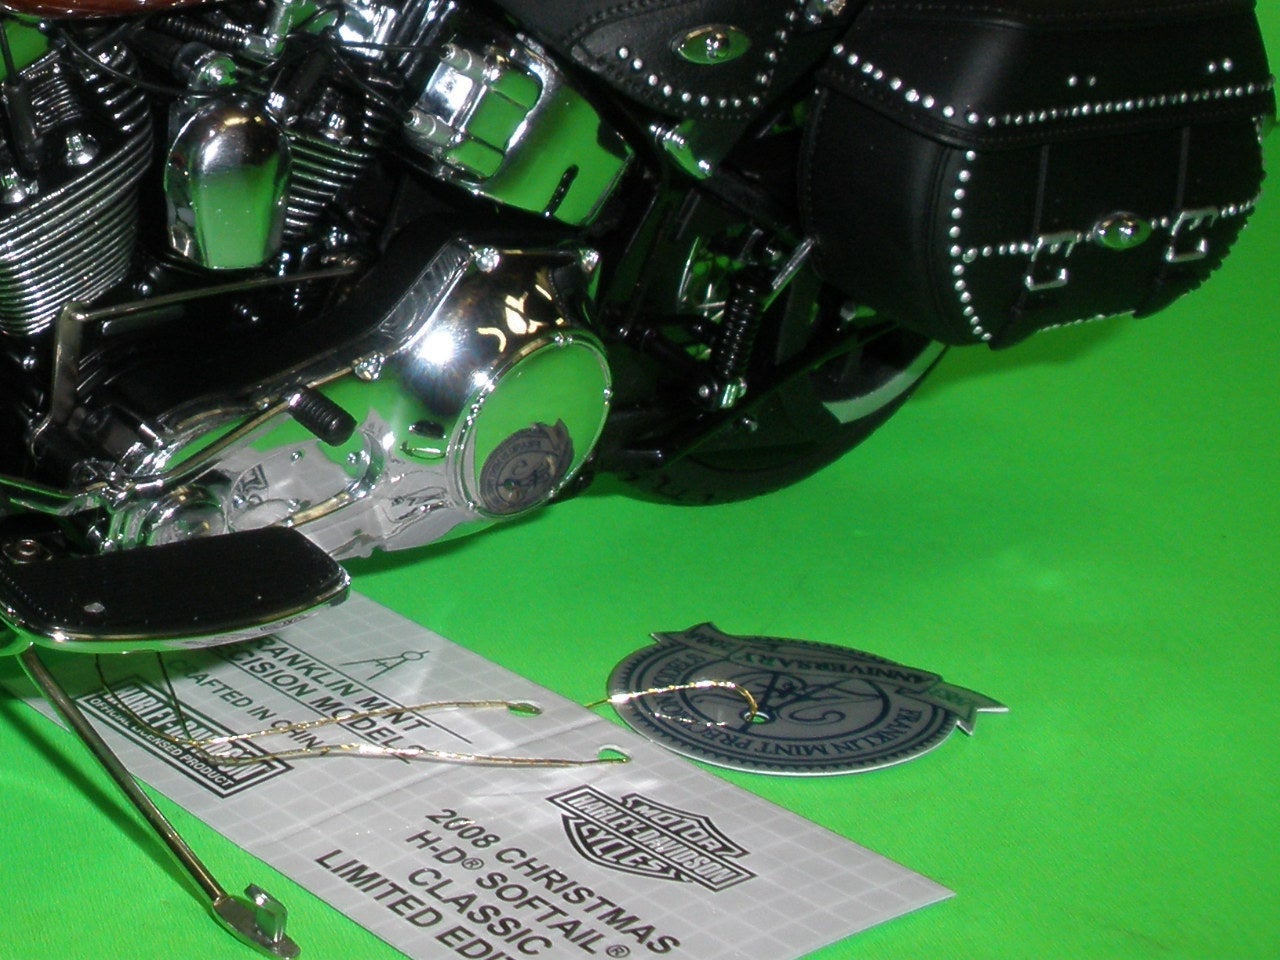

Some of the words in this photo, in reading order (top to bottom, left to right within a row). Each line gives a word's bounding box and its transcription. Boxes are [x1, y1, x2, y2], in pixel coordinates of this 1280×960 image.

[232, 648, 315, 697] CISION
[255, 636, 362, 697] RANKLIN
[355, 695, 431, 731] MNT
[247, 705, 276, 722] IN
[270, 719, 329, 757] CHIN
[754, 741, 827, 757] MINT
[830, 708, 922, 756] FRANKLIN
[179, 754, 235, 789] PRODUCT
[568, 792, 739, 883] HARLEY-DAVIDSON
[579, 820, 669, 873] CYCLES
[635, 803, 723, 851] MOTOR
[315, 848, 444, 928] LIMITED
[424, 808, 502, 849] 2008
[494, 847, 681, 955] CHRISTMAS
[407, 867, 553, 956] CLASSIC
